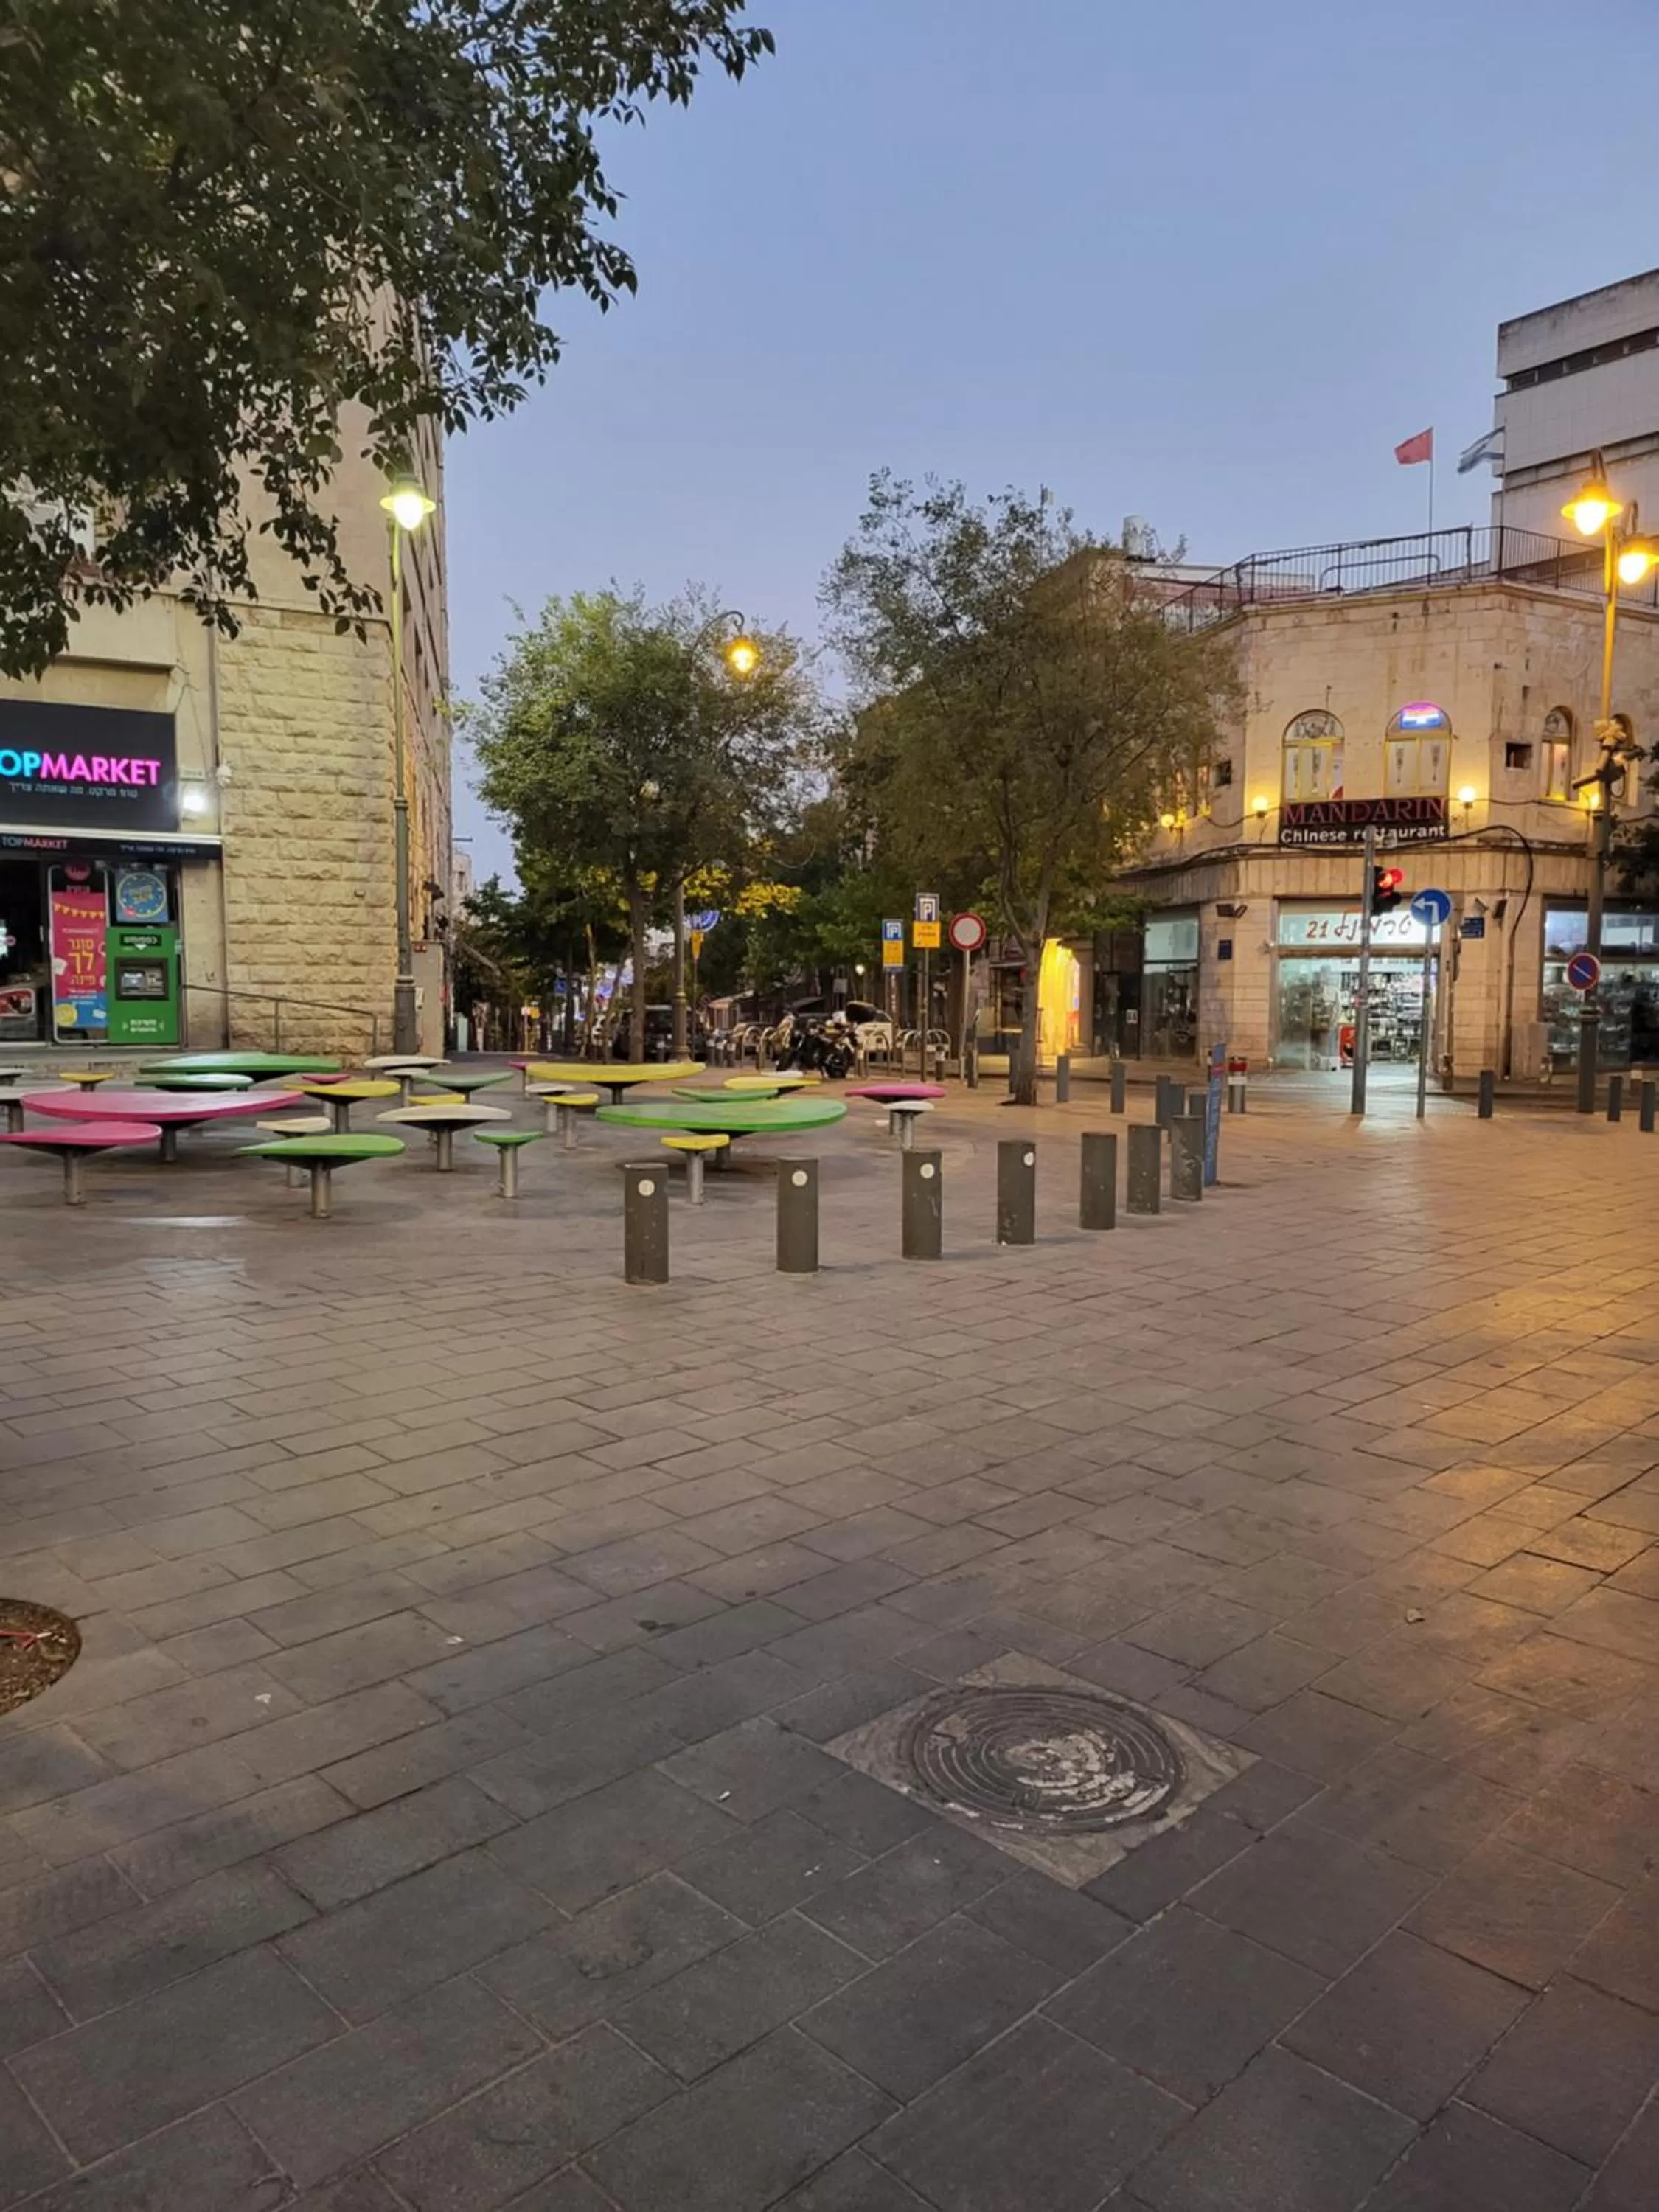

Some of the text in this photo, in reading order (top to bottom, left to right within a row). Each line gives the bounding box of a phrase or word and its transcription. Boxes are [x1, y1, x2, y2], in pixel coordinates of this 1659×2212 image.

[1282, 798, 1447, 826] MANDARIN
[1281, 828, 1348, 844] Chinese
[1306, 911, 1412, 941] טרמנל 21
